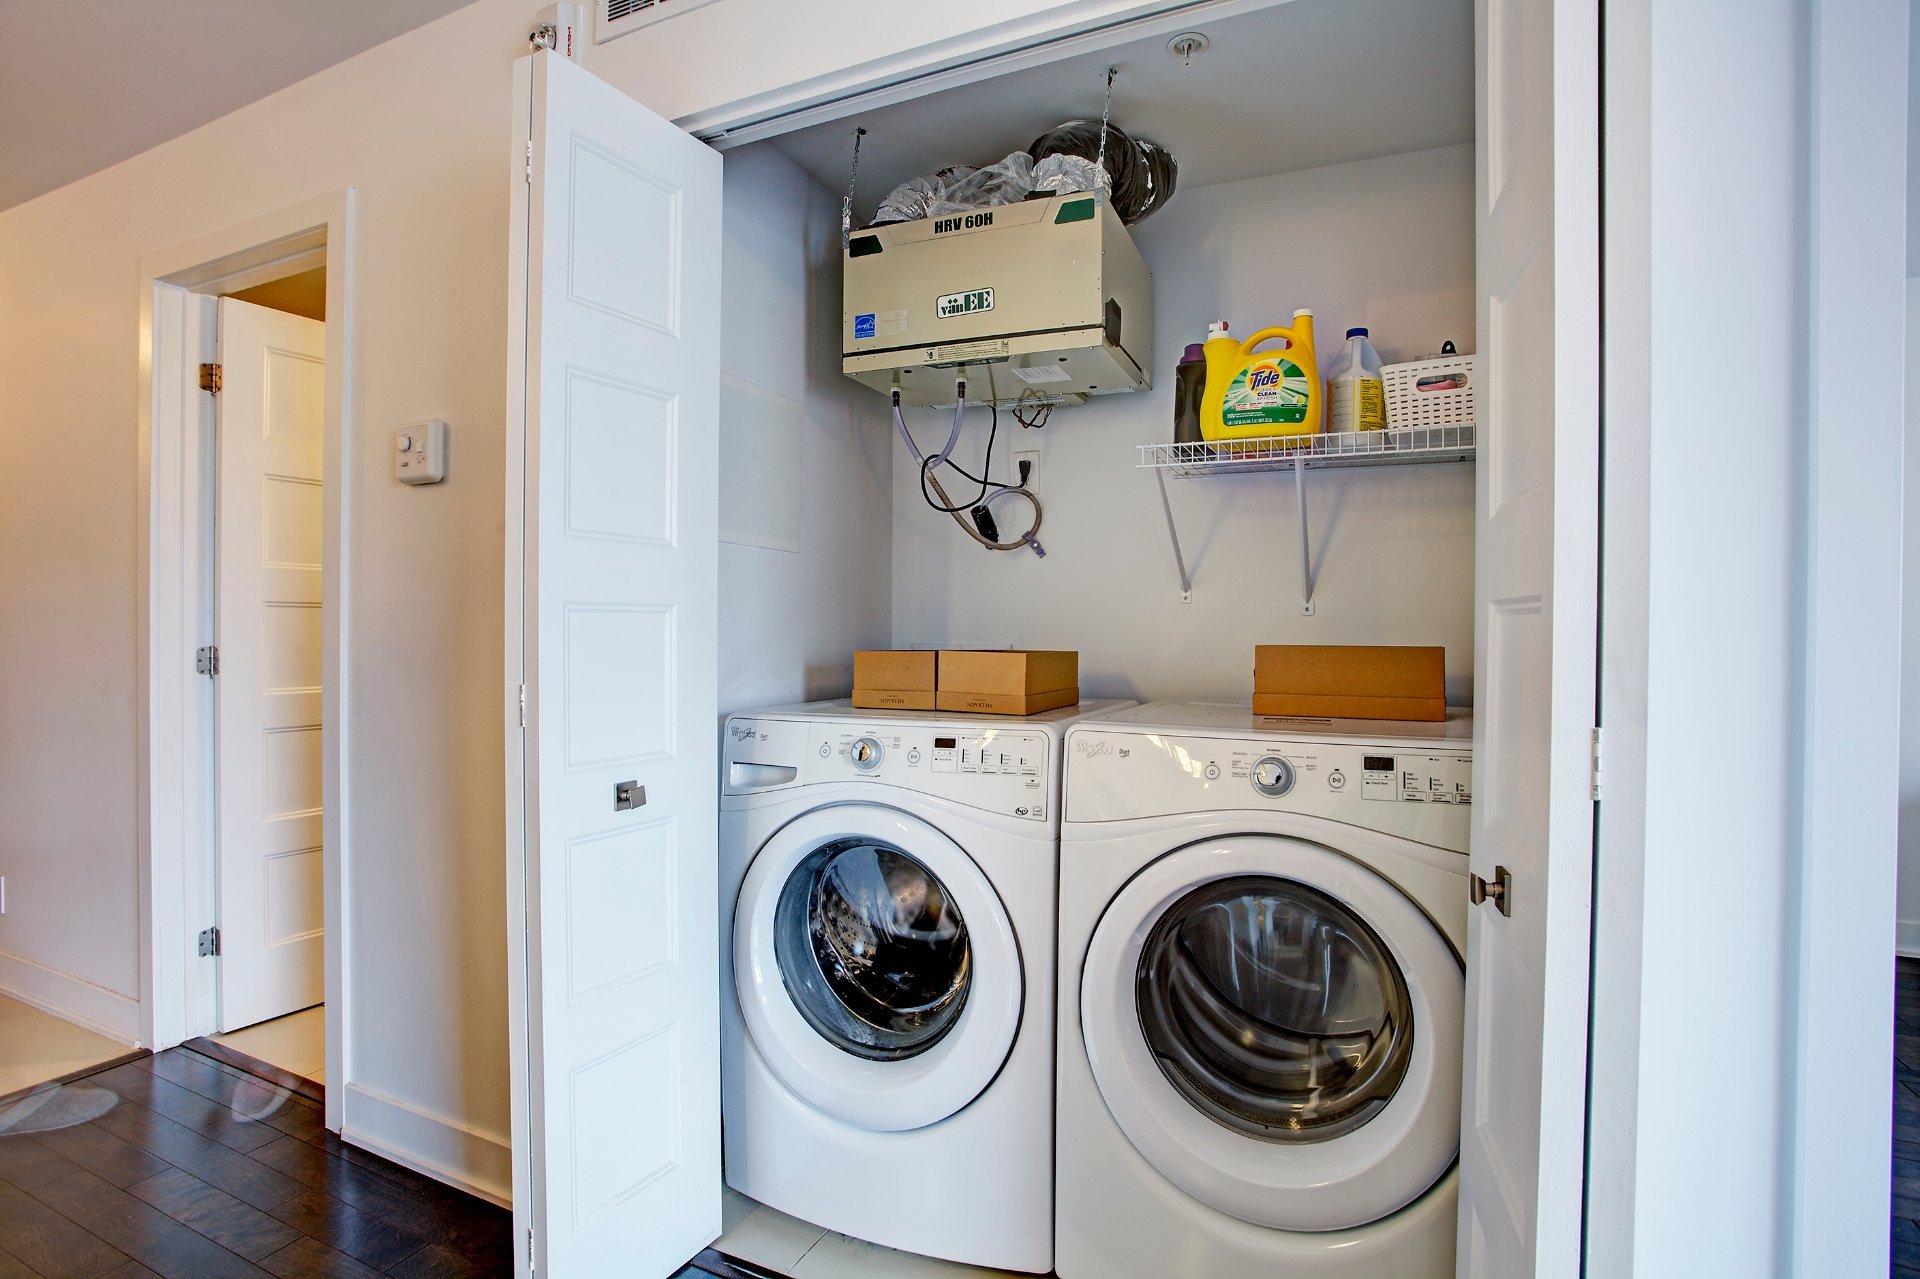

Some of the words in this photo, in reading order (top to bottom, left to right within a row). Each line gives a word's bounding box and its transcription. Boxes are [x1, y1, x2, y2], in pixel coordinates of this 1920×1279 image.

[934, 217, 962, 234] HRV
[965, 212, 993, 229] 60H
[1250, 369, 1281, 391] Tide
